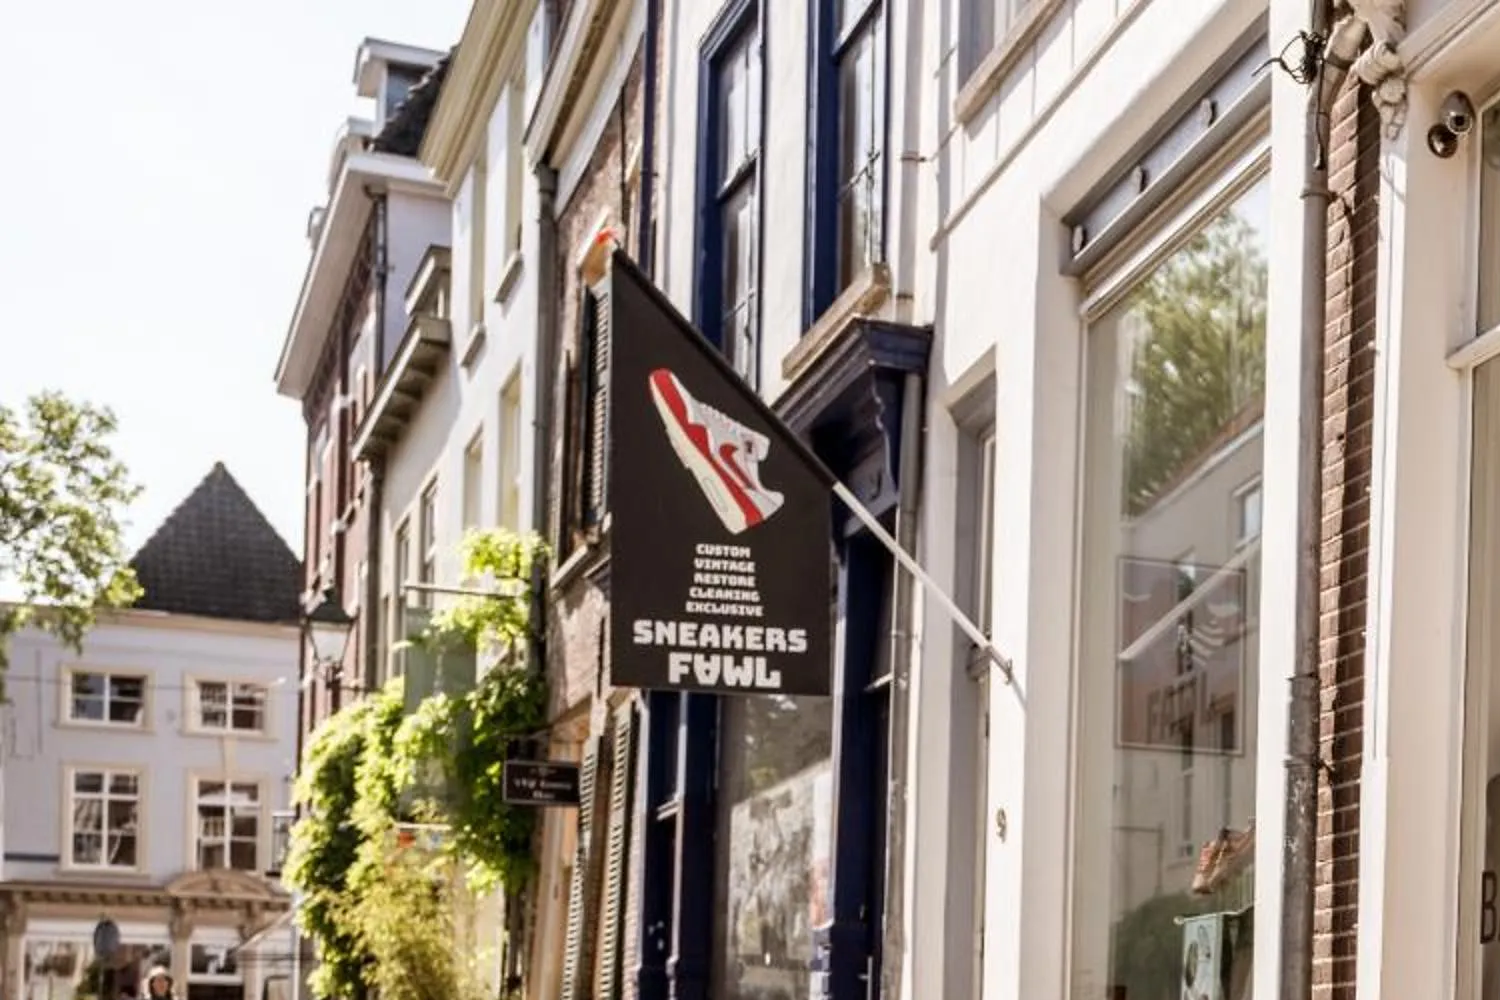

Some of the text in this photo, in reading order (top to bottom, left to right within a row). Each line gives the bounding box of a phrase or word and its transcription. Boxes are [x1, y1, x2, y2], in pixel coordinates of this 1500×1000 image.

[696, 543, 751, 558] CUSTOM
[694, 557, 756, 573] VINTAGE
[694, 572, 756, 588] RESTORE
[689, 587, 760, 603] CLEANING
[685, 600, 764, 617] EXCLUSIVE
[633, 619, 808, 653] SNEAKERS
